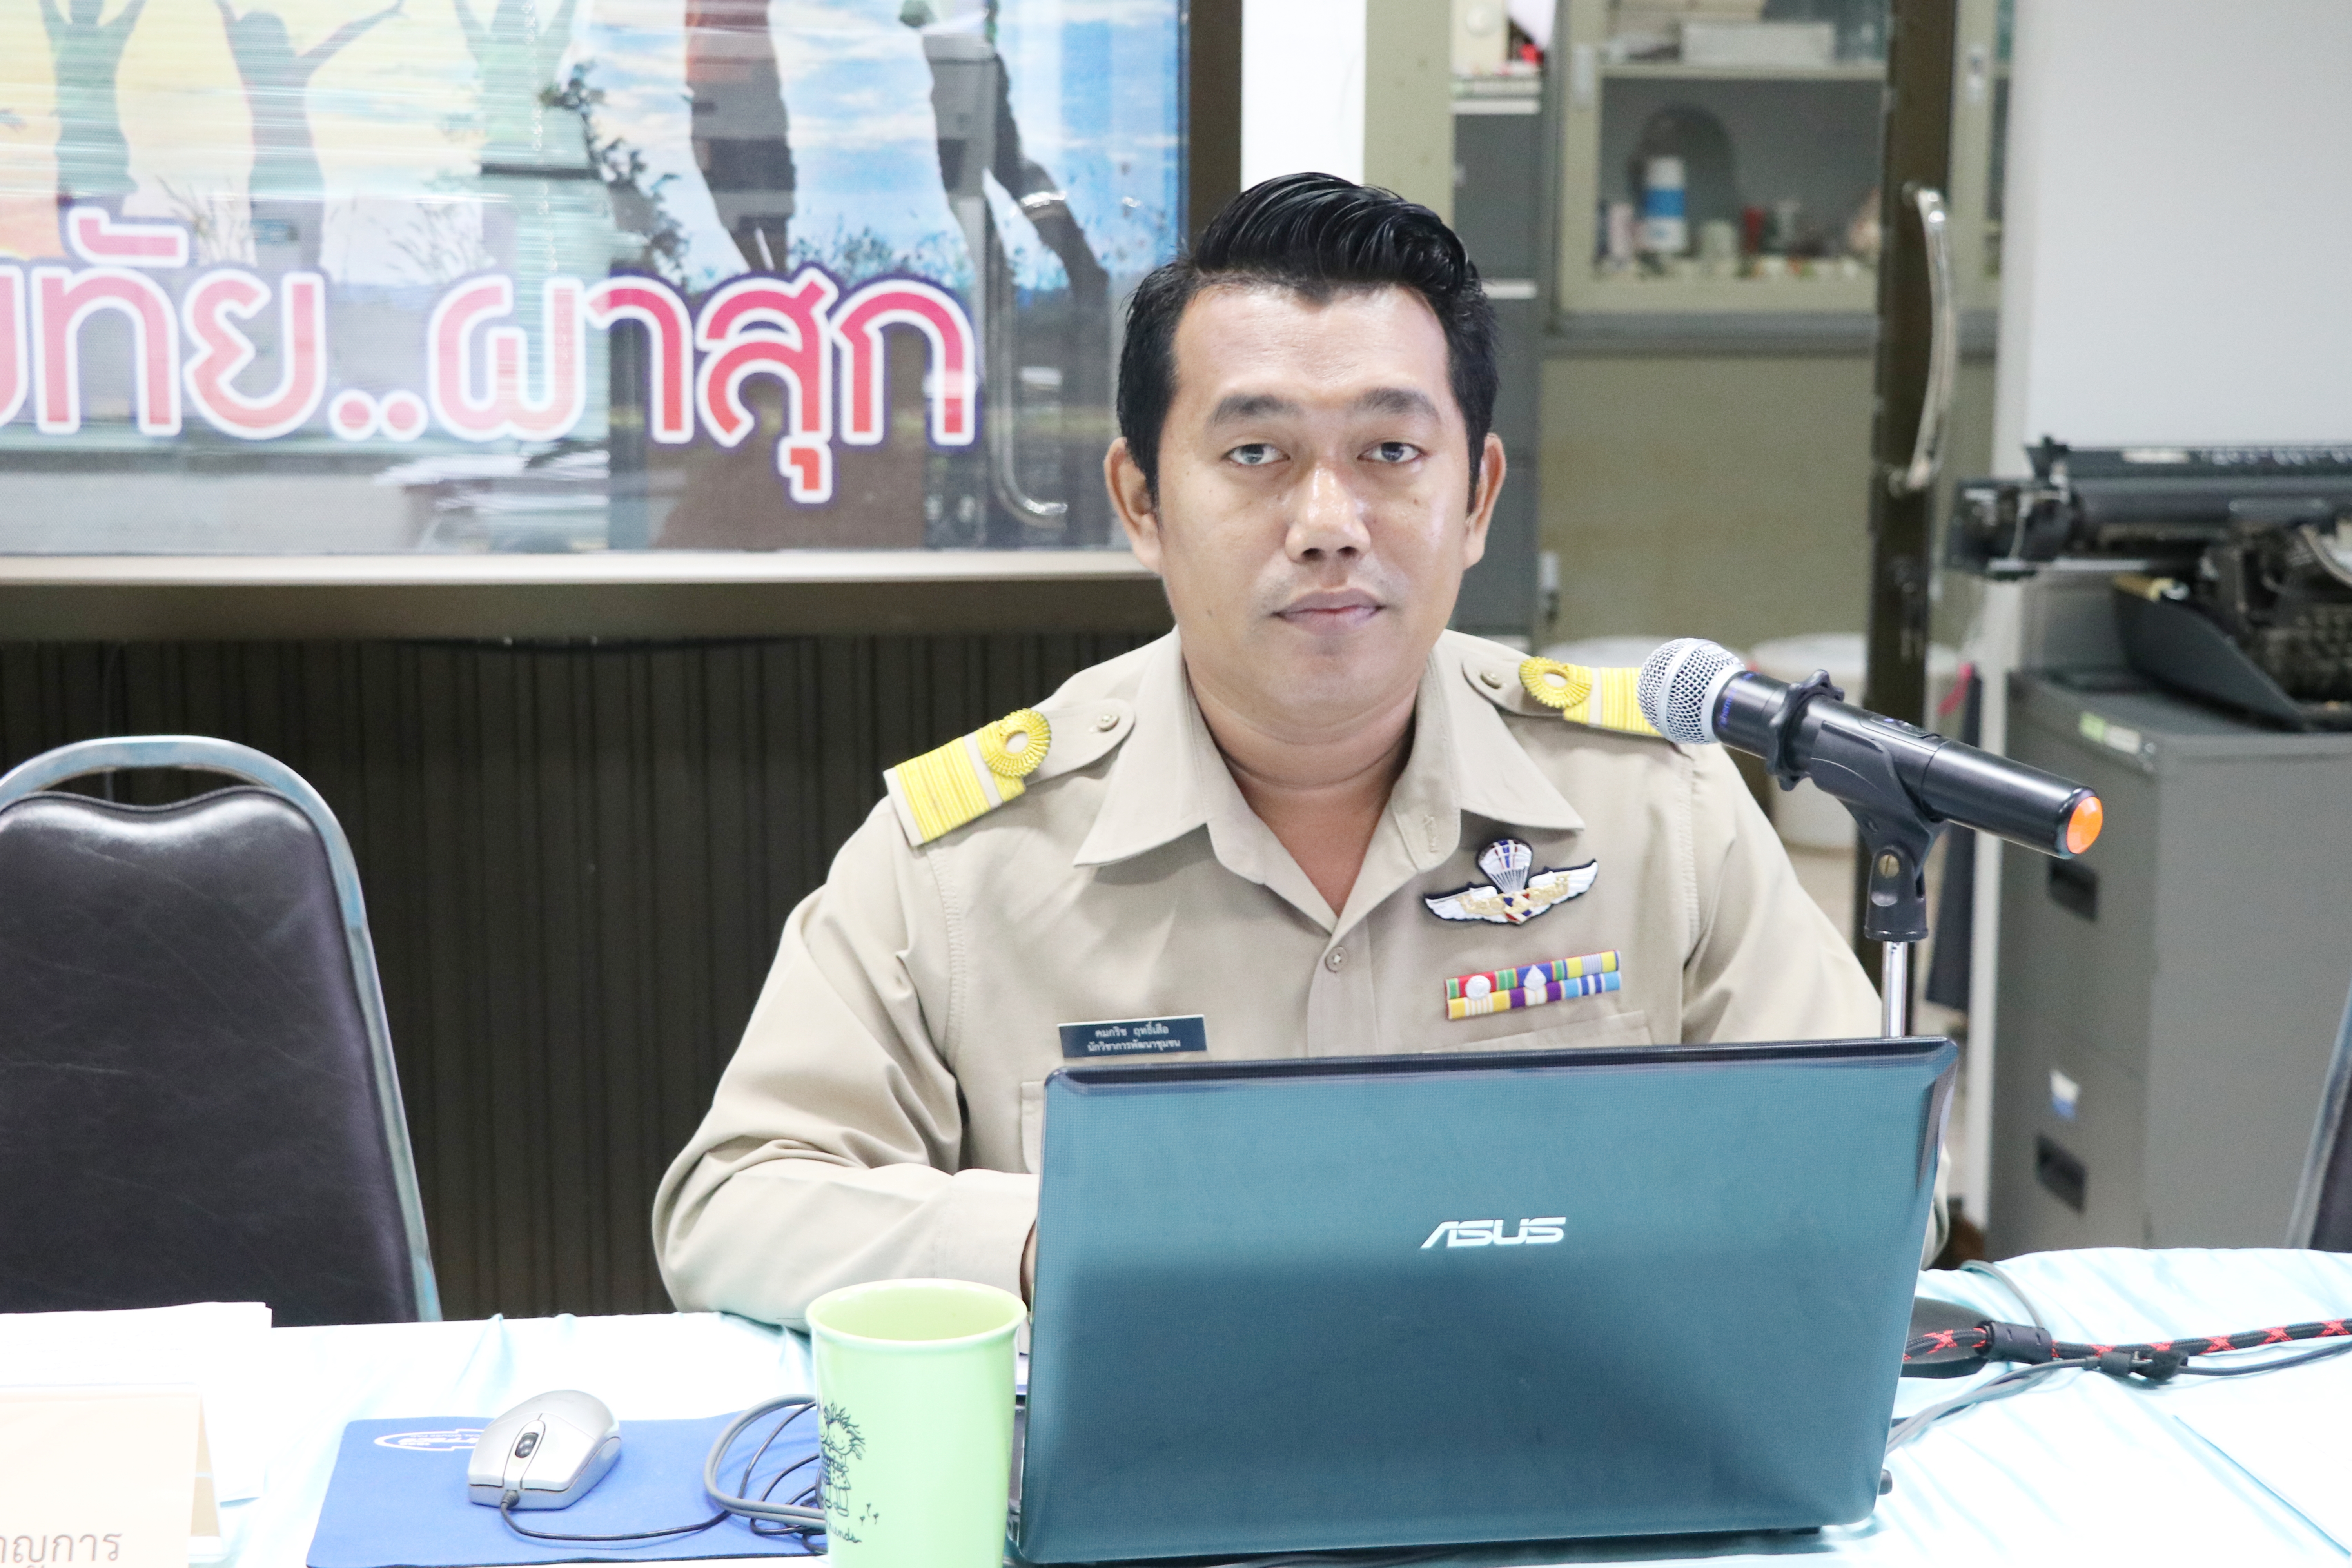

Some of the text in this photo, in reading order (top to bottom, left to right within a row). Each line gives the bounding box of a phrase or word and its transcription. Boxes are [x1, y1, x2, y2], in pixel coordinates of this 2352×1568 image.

[0, 207, 975, 503] ทัย..ผาสุก
[1421, 1216, 1566, 1248] ASUS
